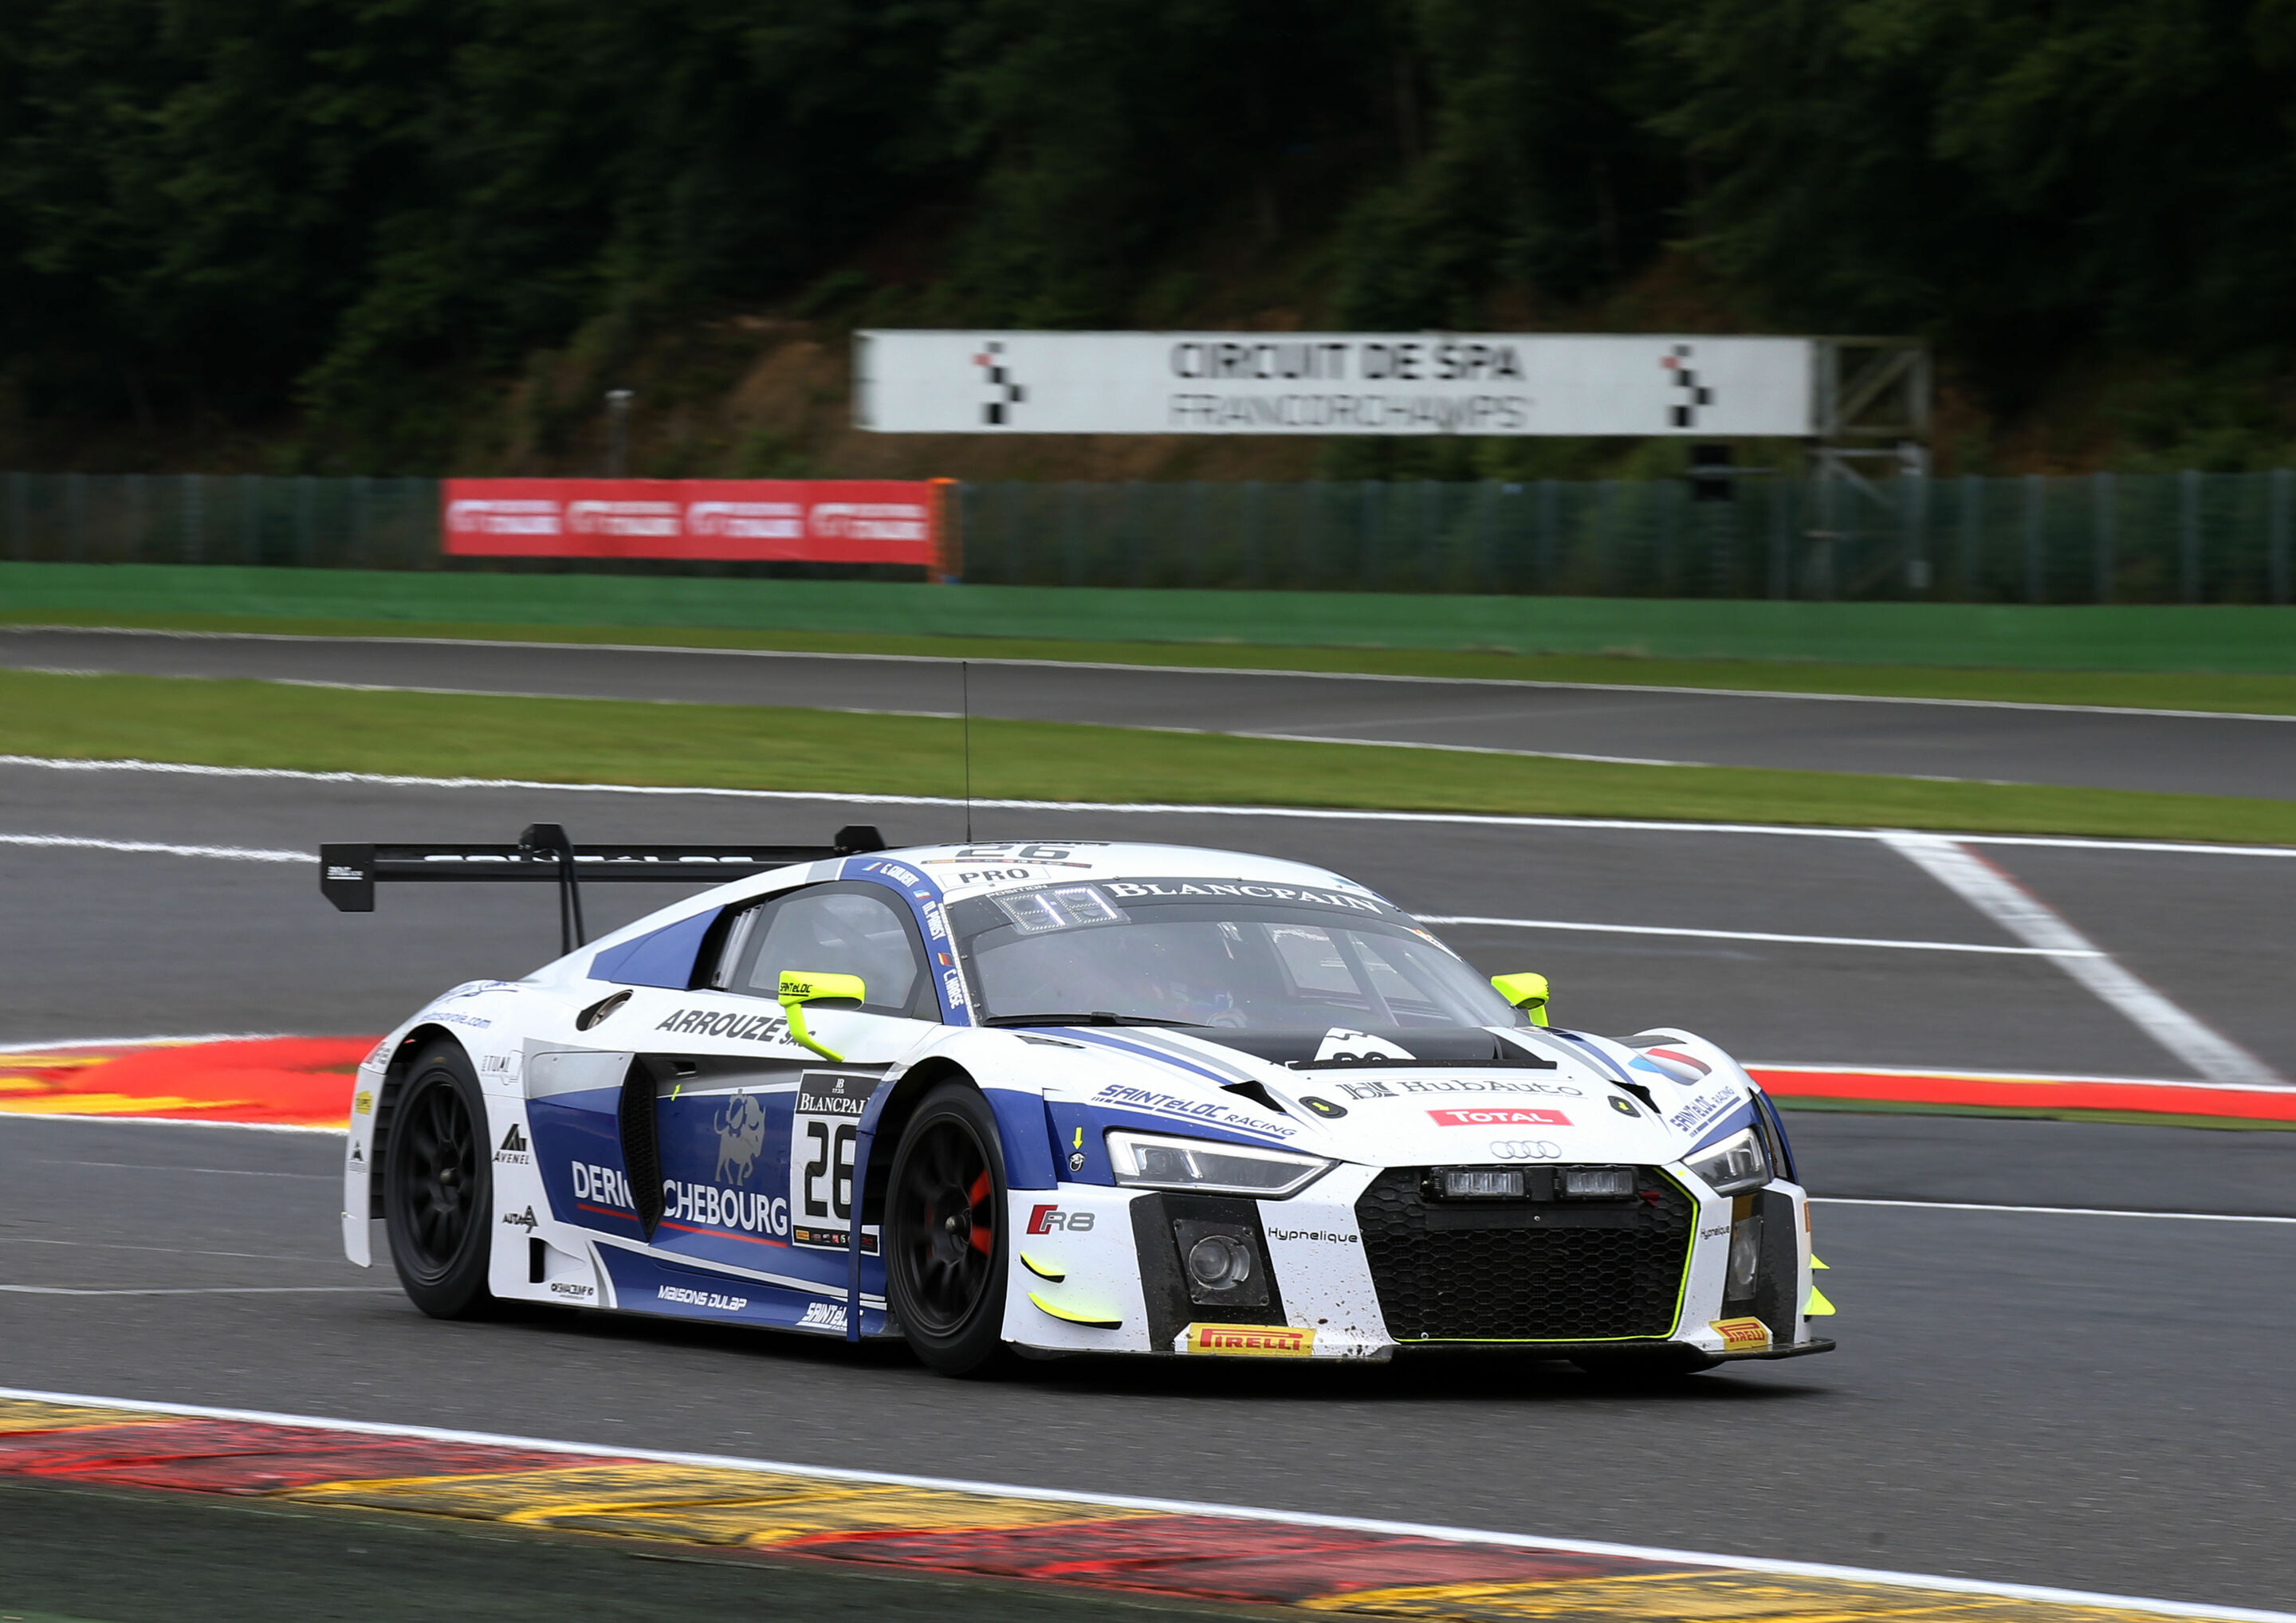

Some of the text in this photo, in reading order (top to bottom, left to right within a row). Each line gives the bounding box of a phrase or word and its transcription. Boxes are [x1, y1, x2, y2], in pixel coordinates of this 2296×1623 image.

[1170, 342, 1527, 380] CIRCUIT DE SPA
[1168, 393, 1528, 429] FRANCORCHAMPS
[956, 844, 1076, 859] 26
[958, 868, 1030, 883] PRO
[985, 884, 1048, 898] POSITION
[1102, 882, 1384, 914] BLANCPAIN
[800, 1093, 871, 1114] BLANCPAI
[1225, 1114, 1298, 1136] RACING
[1445, 1110, 1555, 1122] TOTAL
[492, 1151, 530, 1165] AVENEL
[804, 1122, 857, 1220] 26
[1040, 1211, 1095, 1232] R8
[1268, 1227, 1358, 1244] Hypnelique
[1200, 1328, 1303, 1350] PIRELLI
[1719, 1322, 1766, 1342] PIRELLI
